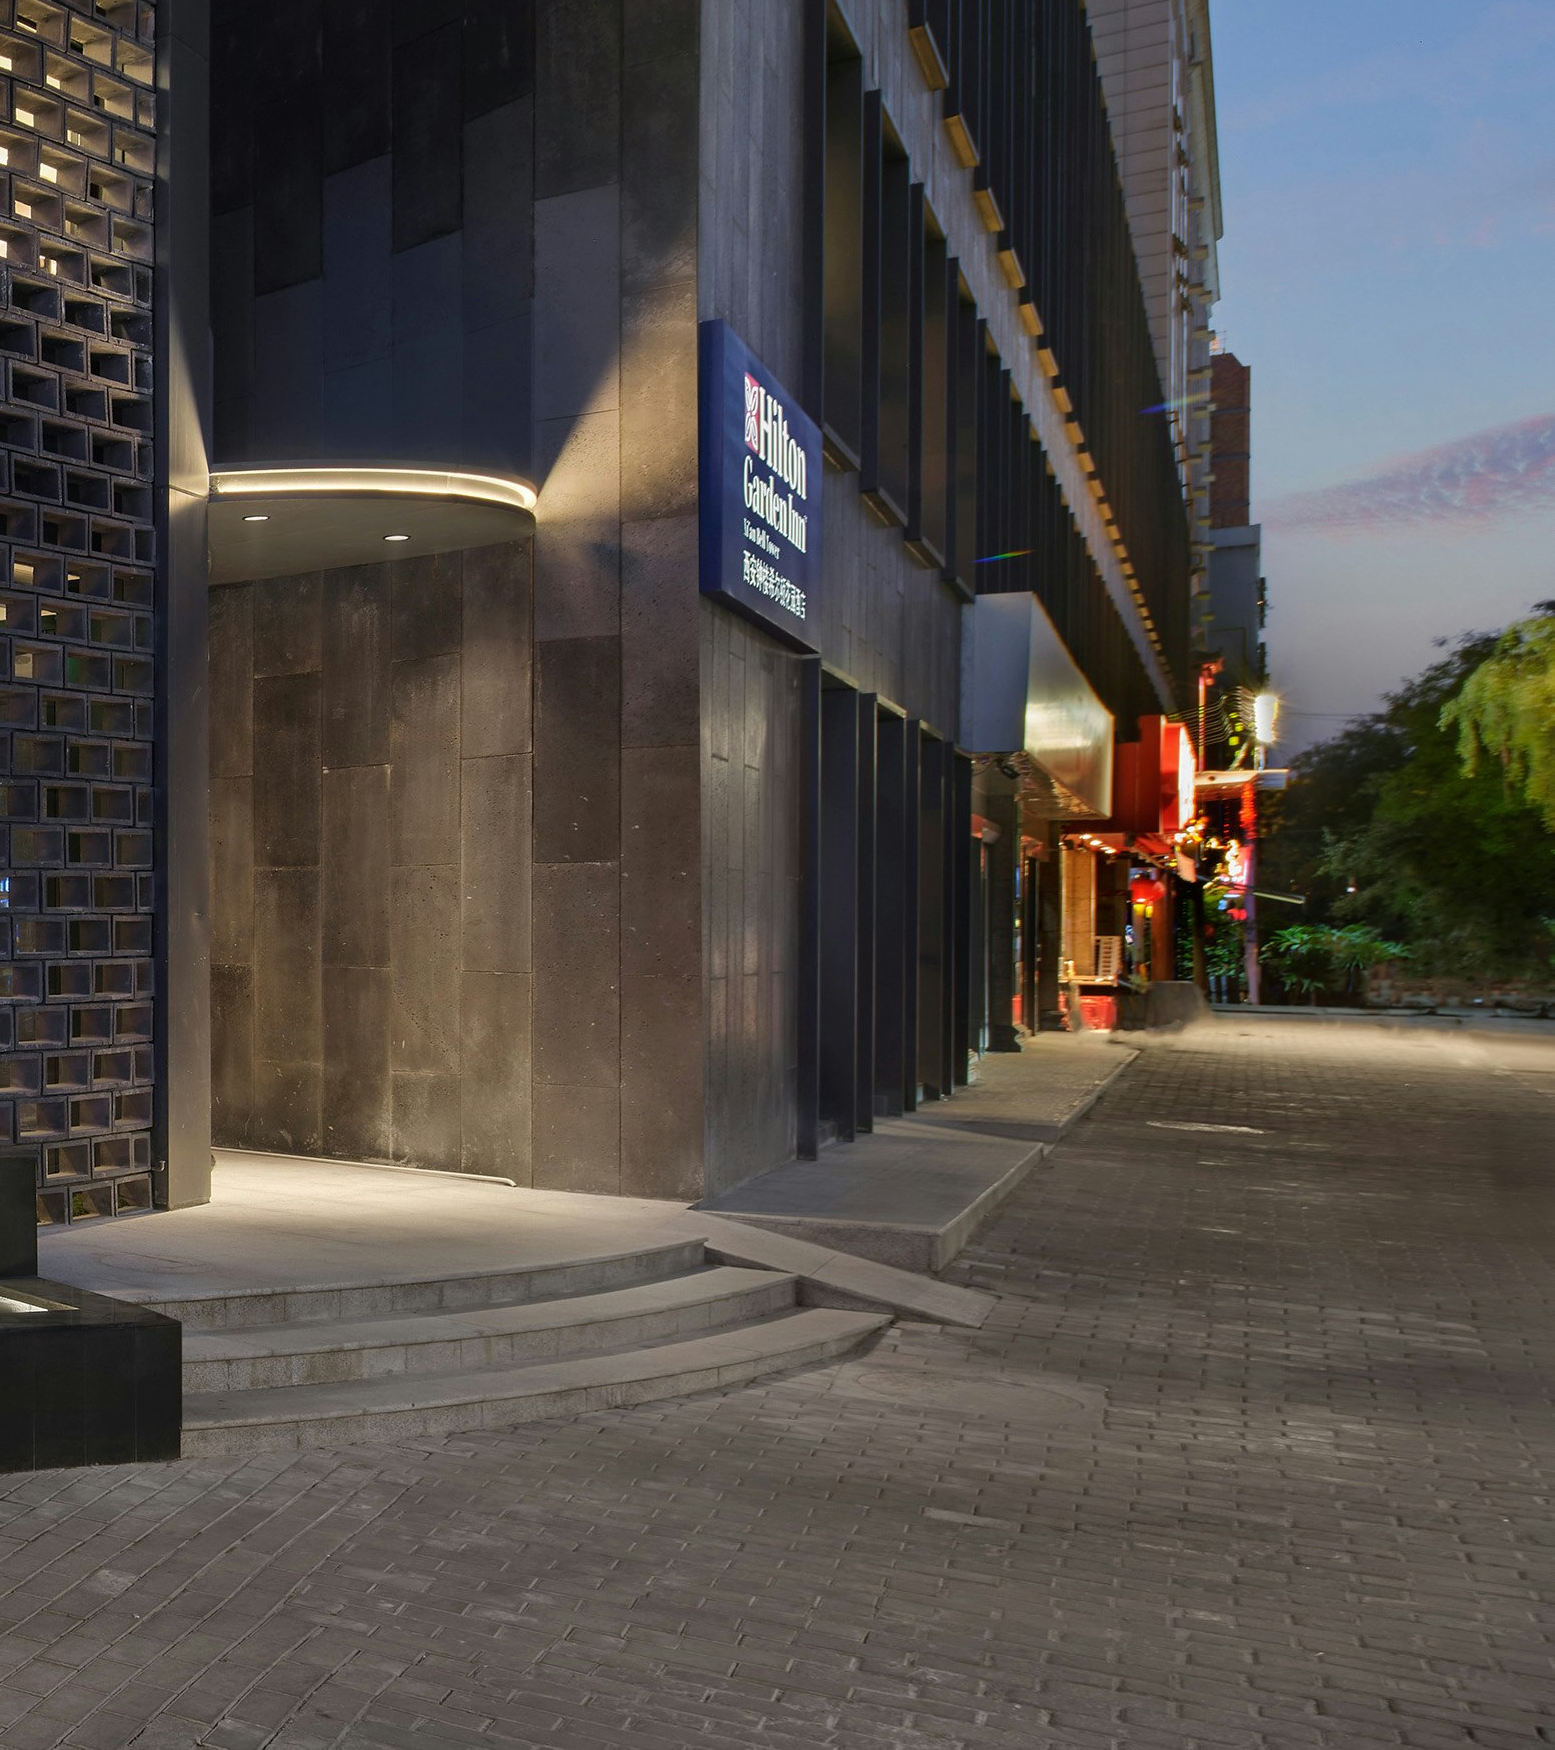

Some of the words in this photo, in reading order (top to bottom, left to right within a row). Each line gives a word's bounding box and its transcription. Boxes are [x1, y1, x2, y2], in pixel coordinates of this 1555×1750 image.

[759, 386, 807, 500] Hilton
[744, 455, 788, 538] Garden
[788, 493, 807, 553] Inn
